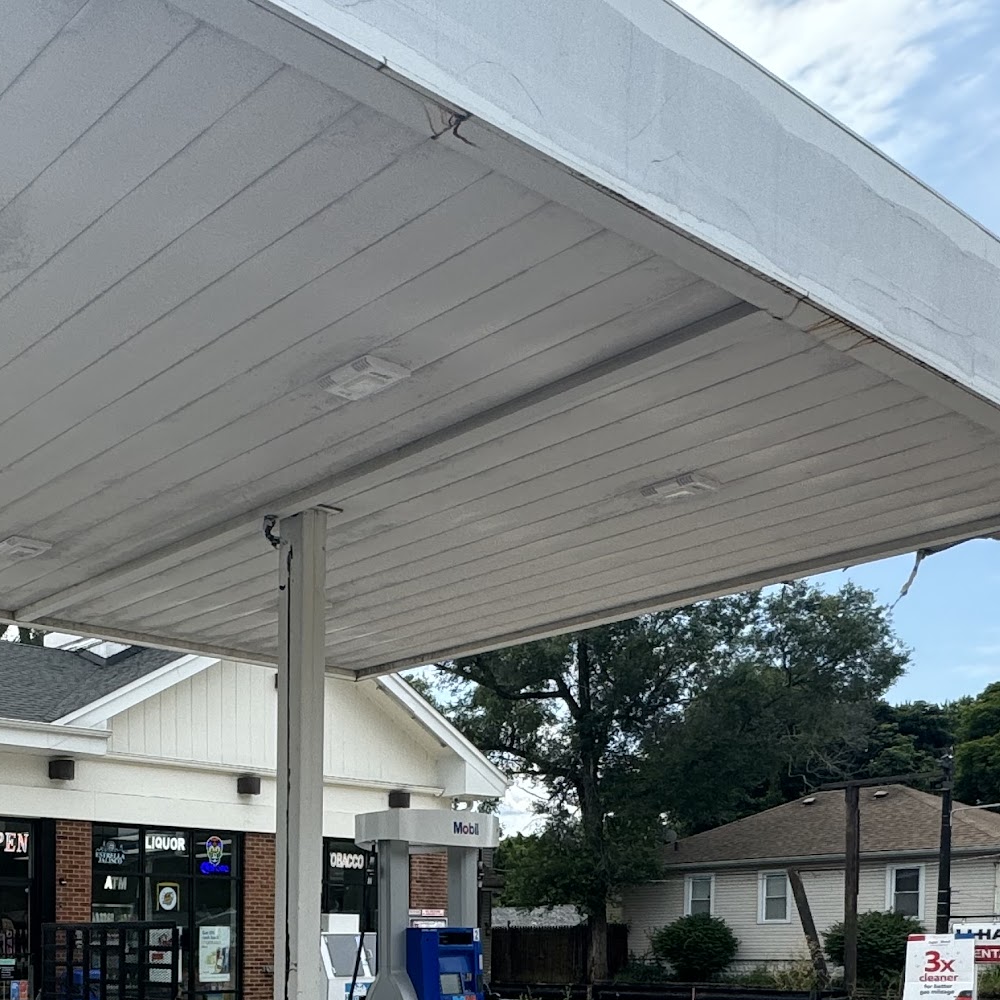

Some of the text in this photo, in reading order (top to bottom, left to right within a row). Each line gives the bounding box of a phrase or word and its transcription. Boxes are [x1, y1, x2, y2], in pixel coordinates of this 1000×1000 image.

[453, 821, 480, 835] Mobil
[145, 835, 186, 851] LIQUOR
[330, 851, 364, 870] OBACCO
[104, 875, 127, 890] ATM
[924, 950, 956, 973] 3x
[919, 973, 959, 982] cleaner
